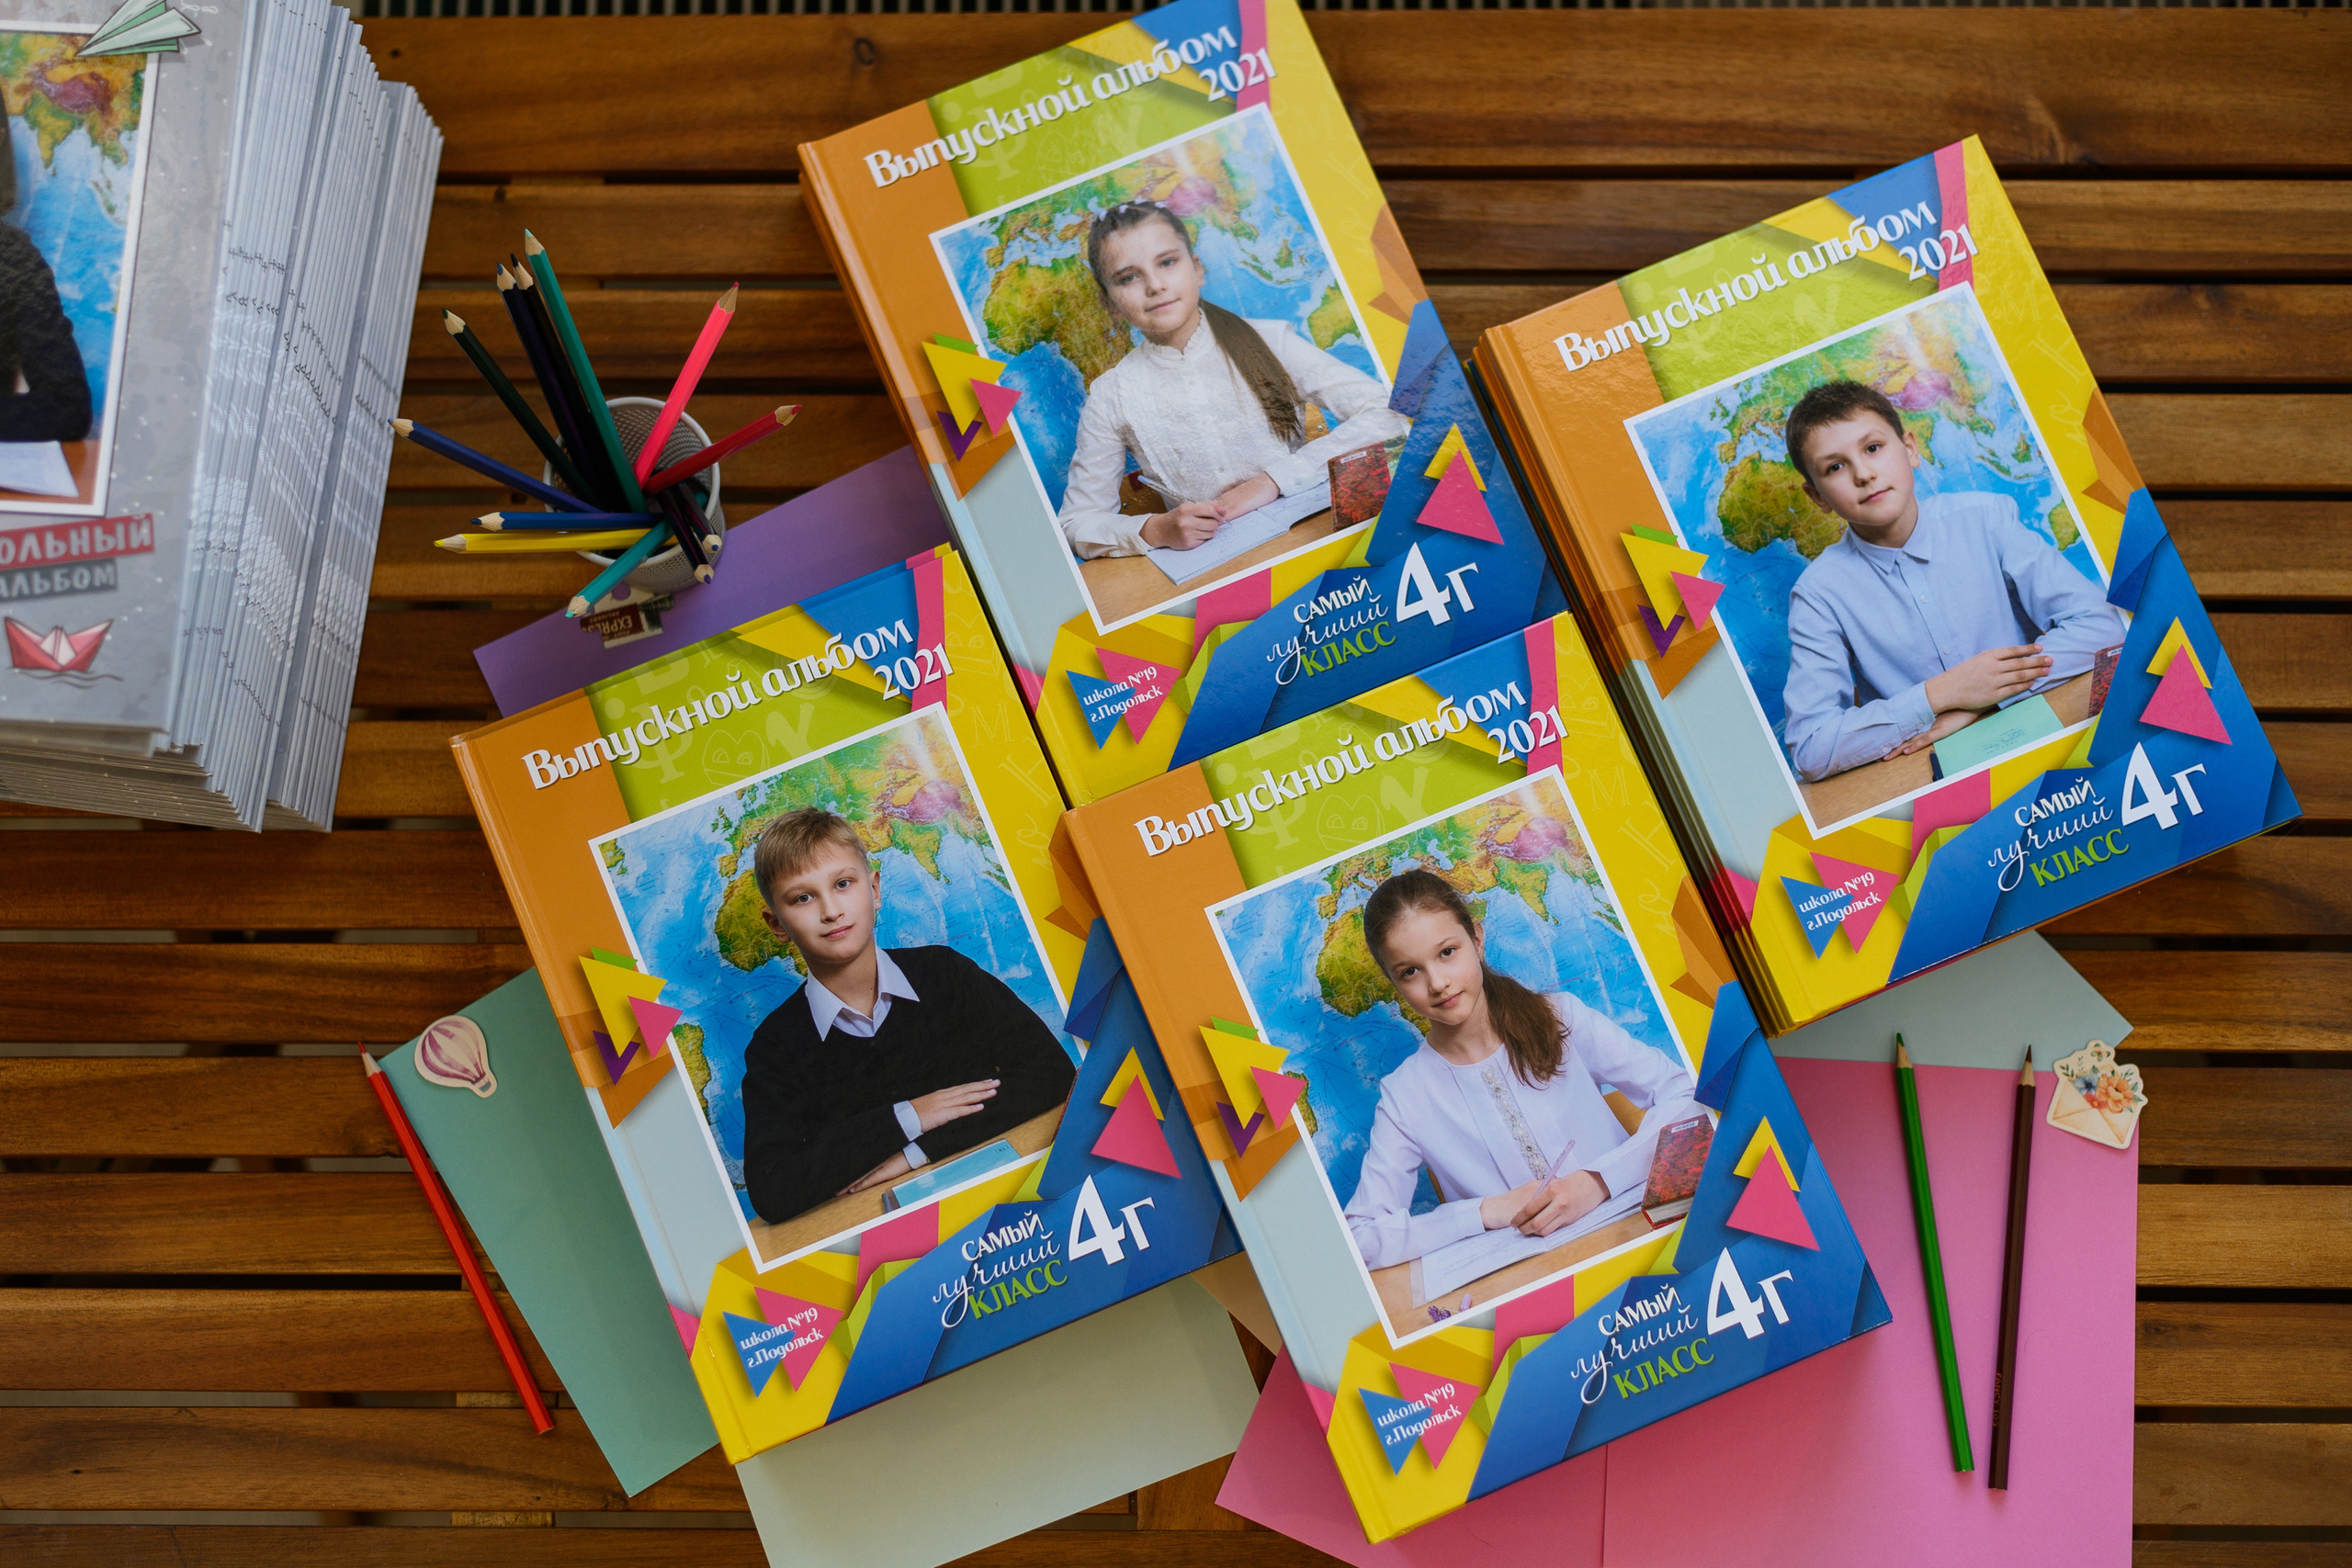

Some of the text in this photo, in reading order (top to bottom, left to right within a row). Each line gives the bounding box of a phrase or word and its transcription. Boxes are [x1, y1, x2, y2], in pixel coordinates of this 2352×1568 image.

[1199, 47, 1276, 103] 2021
[863, 25, 1238, 188] Выпускной альбом
[1898, 223, 1979, 281] 2021
[1553, 200, 1937, 372] Выпускной альбом
[1267, 597, 1388, 685] лучший
[1300, 622, 1396, 677] КЛАСС
[873, 642, 954, 700] 2021
[1083, 677, 1129, 705] школа
[521, 619, 914, 790] Выпускной альбом
[1487, 705, 1568, 763] 2021
[1134, 681, 1527, 857] Выпускной альбом
[1988, 797, 2113, 892] лучший
[2029, 829, 2130, 887] КЛАСС
[1799, 886, 1847, 914] школа
[933, 1231, 1060, 1328] лучший
[967, 1260, 1069, 1319] КЛАСС
[741, 1323, 788, 1350] школа
[1570, 1305, 1699, 1404] лучший
[1611, 1338, 1714, 1400] КЛАСС
[1377, 1397, 1425, 1427] школа
